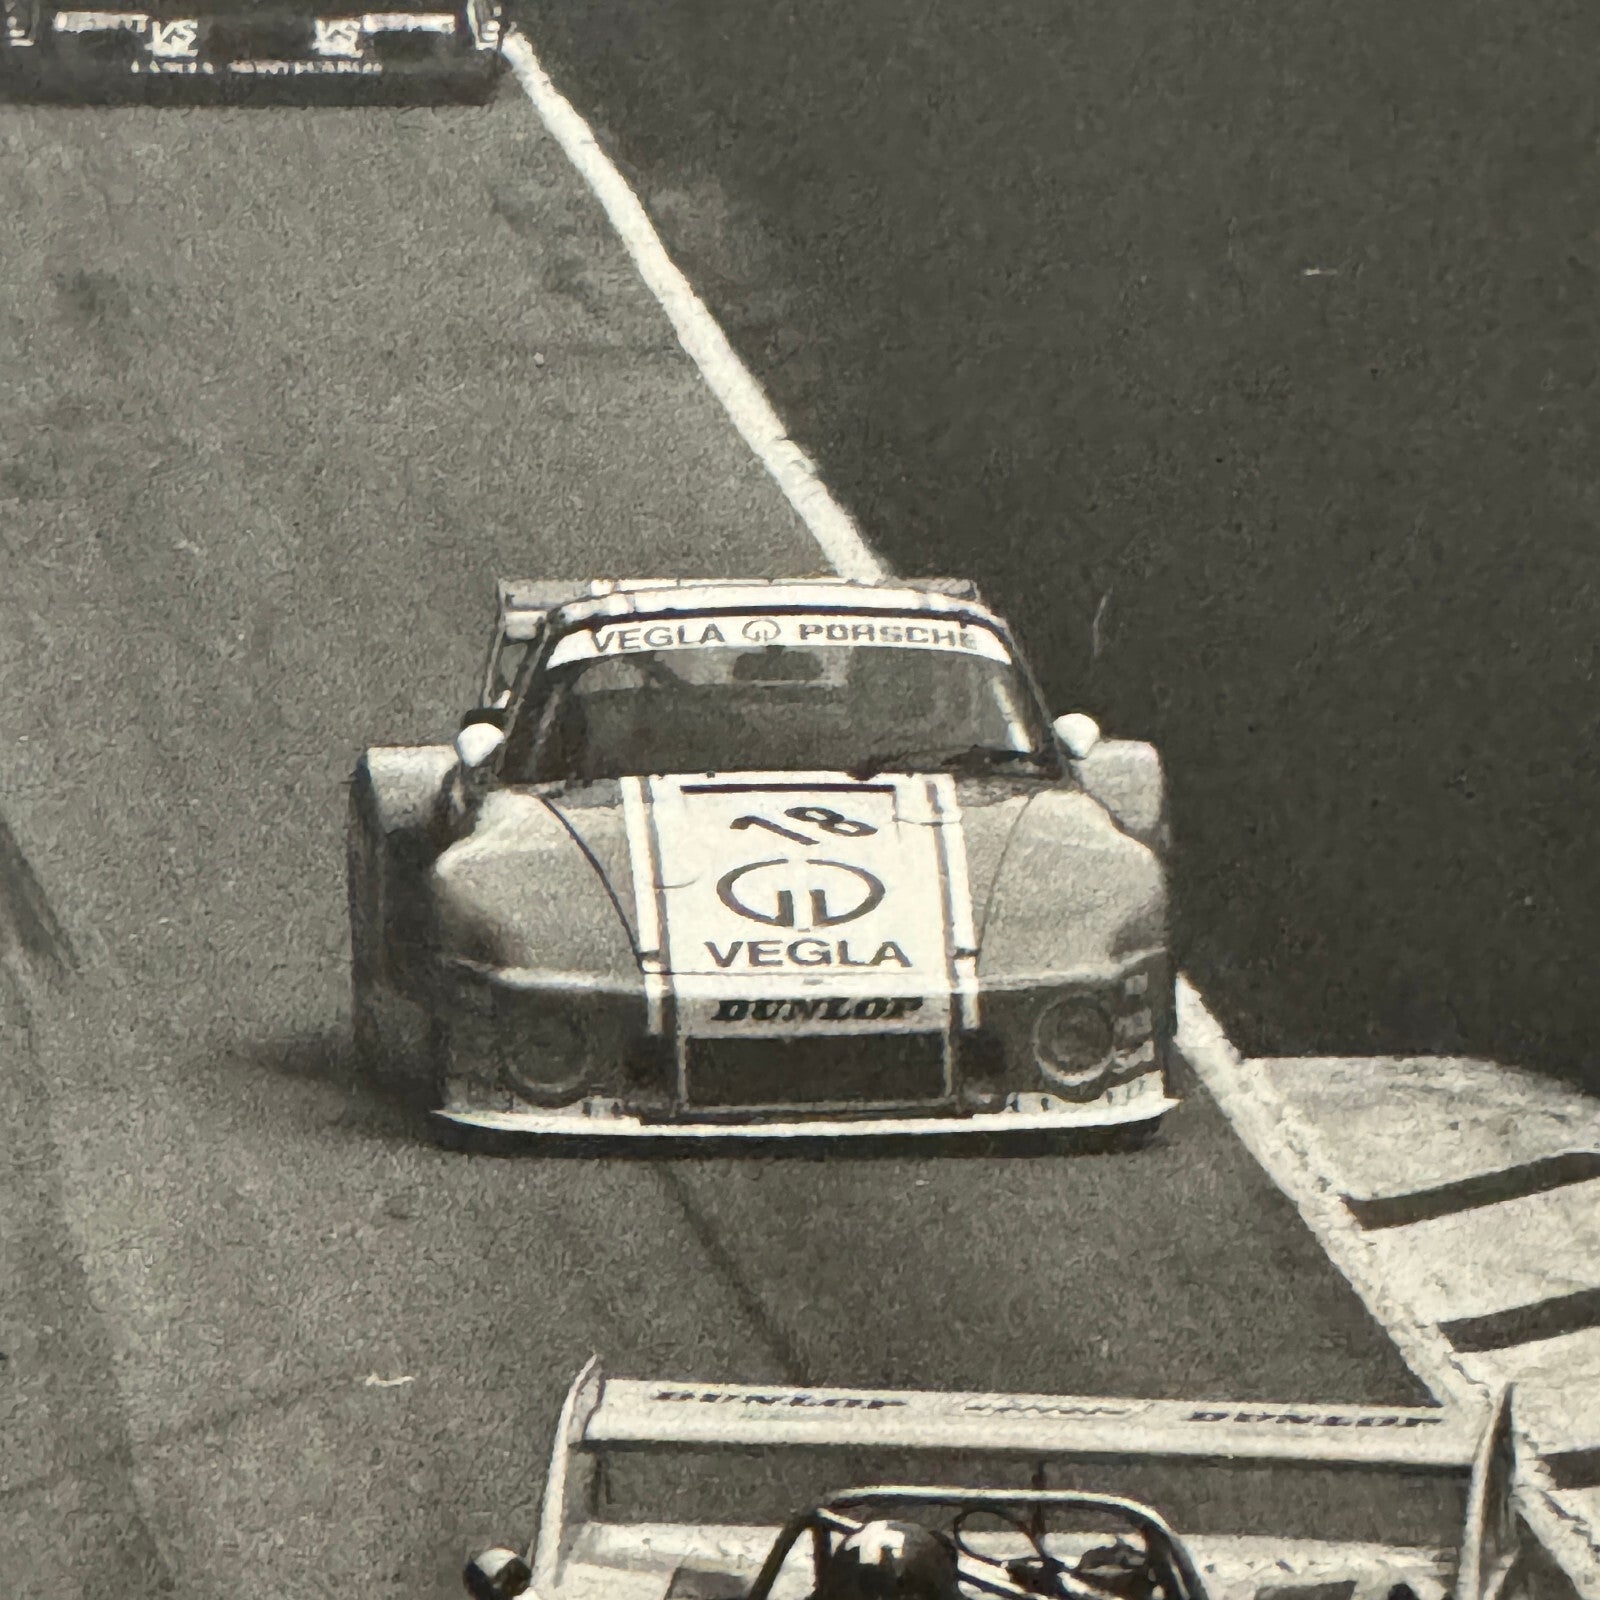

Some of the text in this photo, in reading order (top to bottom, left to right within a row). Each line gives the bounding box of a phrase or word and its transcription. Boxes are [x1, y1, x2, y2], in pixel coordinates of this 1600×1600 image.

[592, 622, 978, 653] VEGLA PORSCHE
[729, 806, 878, 845] 18
[704, 938, 913, 968] VEGLA
[710, 997, 924, 1022] DUNLOP
